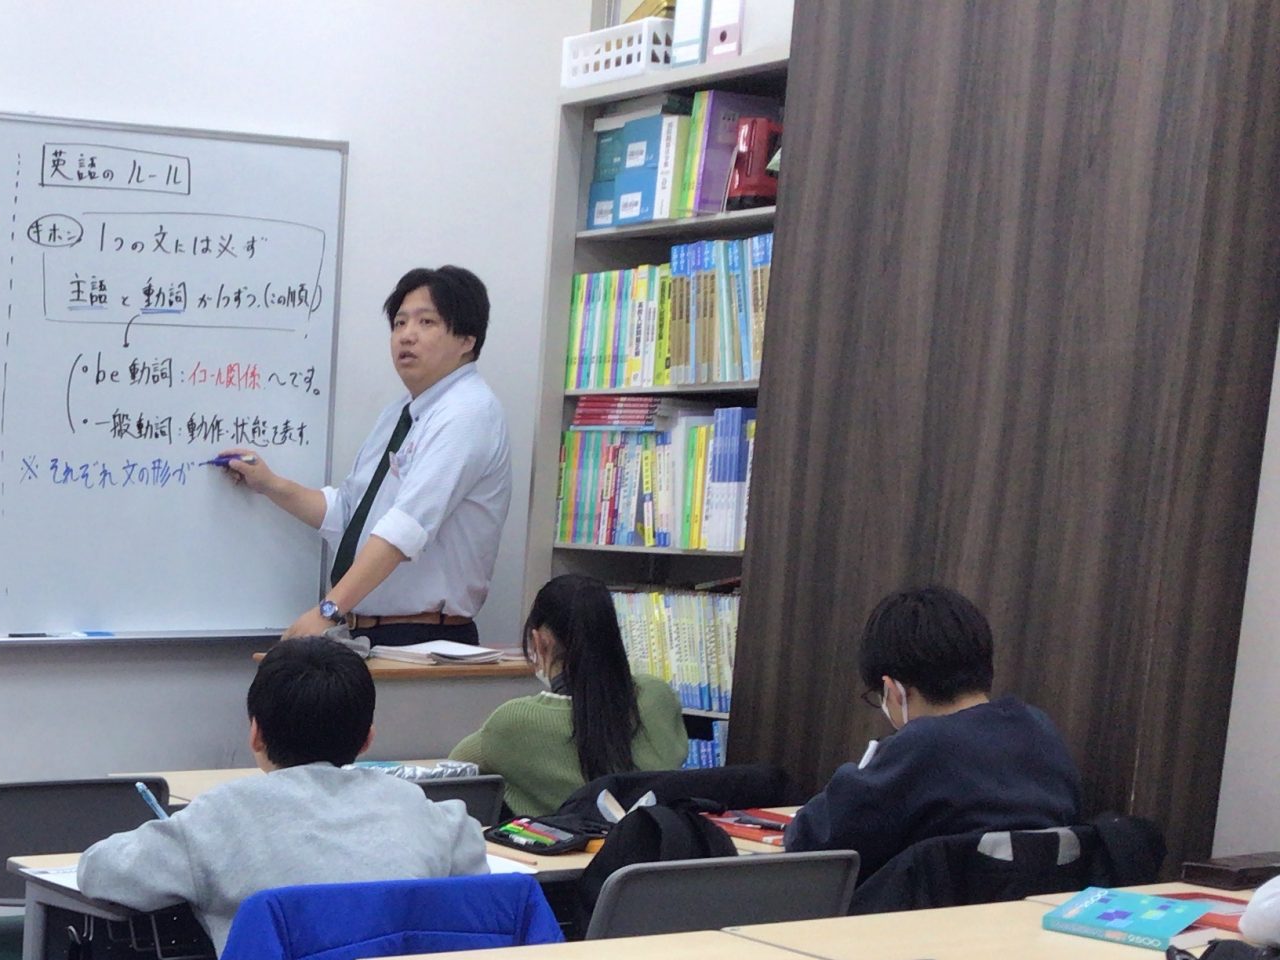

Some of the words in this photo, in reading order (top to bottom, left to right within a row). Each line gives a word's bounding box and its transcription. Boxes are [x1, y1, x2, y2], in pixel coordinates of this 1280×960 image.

[50, 149, 183, 186] 英語のルール
